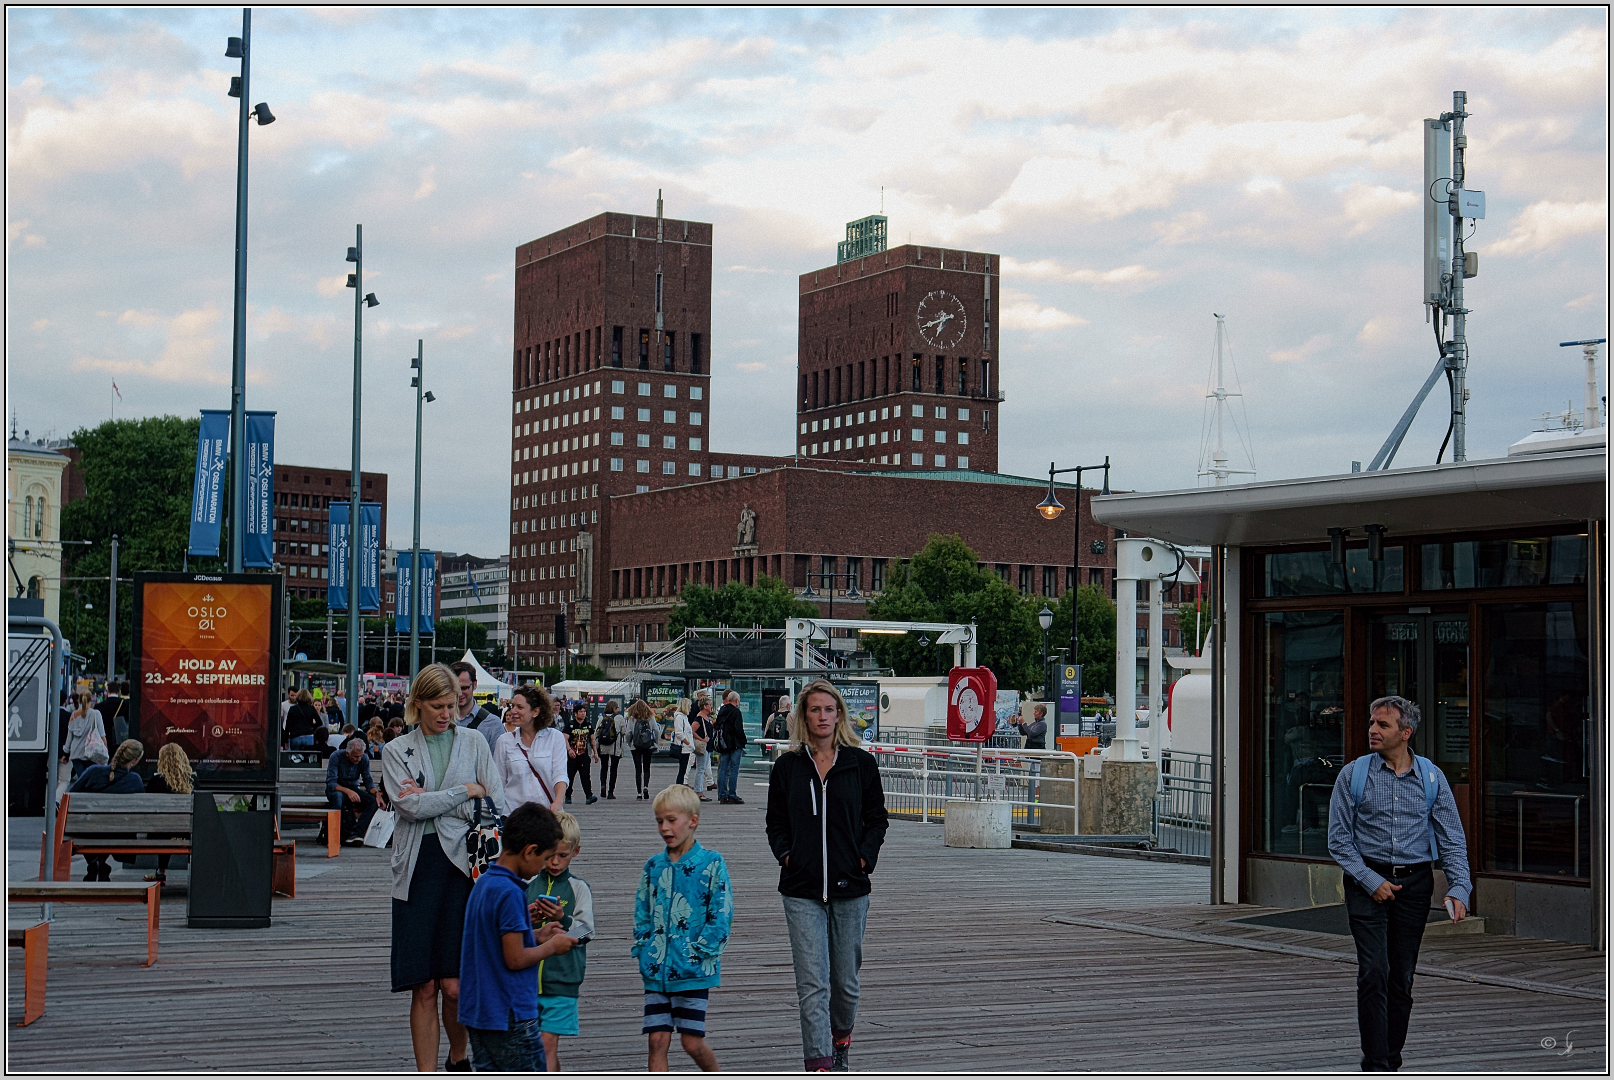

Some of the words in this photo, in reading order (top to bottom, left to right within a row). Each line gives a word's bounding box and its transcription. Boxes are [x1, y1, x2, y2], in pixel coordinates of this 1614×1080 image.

[209, 491, 218, 524] MARATON
[188, 606, 227, 618] OSLO
[198, 619, 215, 630] ØL
[179, 659, 214, 670] HOLD
[218, 660, 237, 671] AV
[196, 673, 265, 685] SEPTEMBER
[840, 688, 859, 696] TASTE
